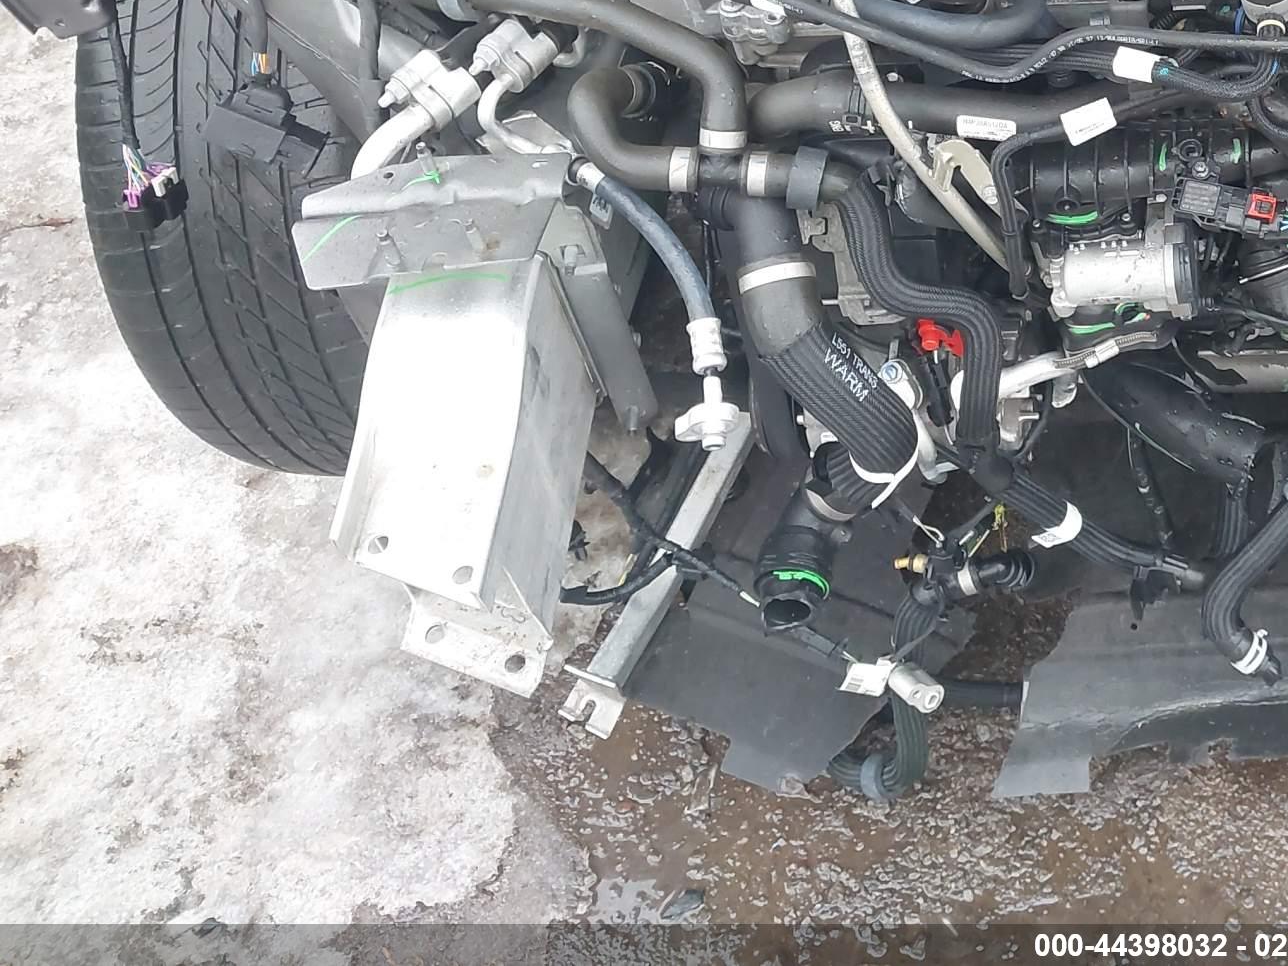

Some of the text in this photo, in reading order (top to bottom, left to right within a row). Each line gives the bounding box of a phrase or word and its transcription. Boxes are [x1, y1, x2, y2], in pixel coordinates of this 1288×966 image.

[824, 346, 870, 403] WARM
[831, 332, 879, 390] L551 TRANS
